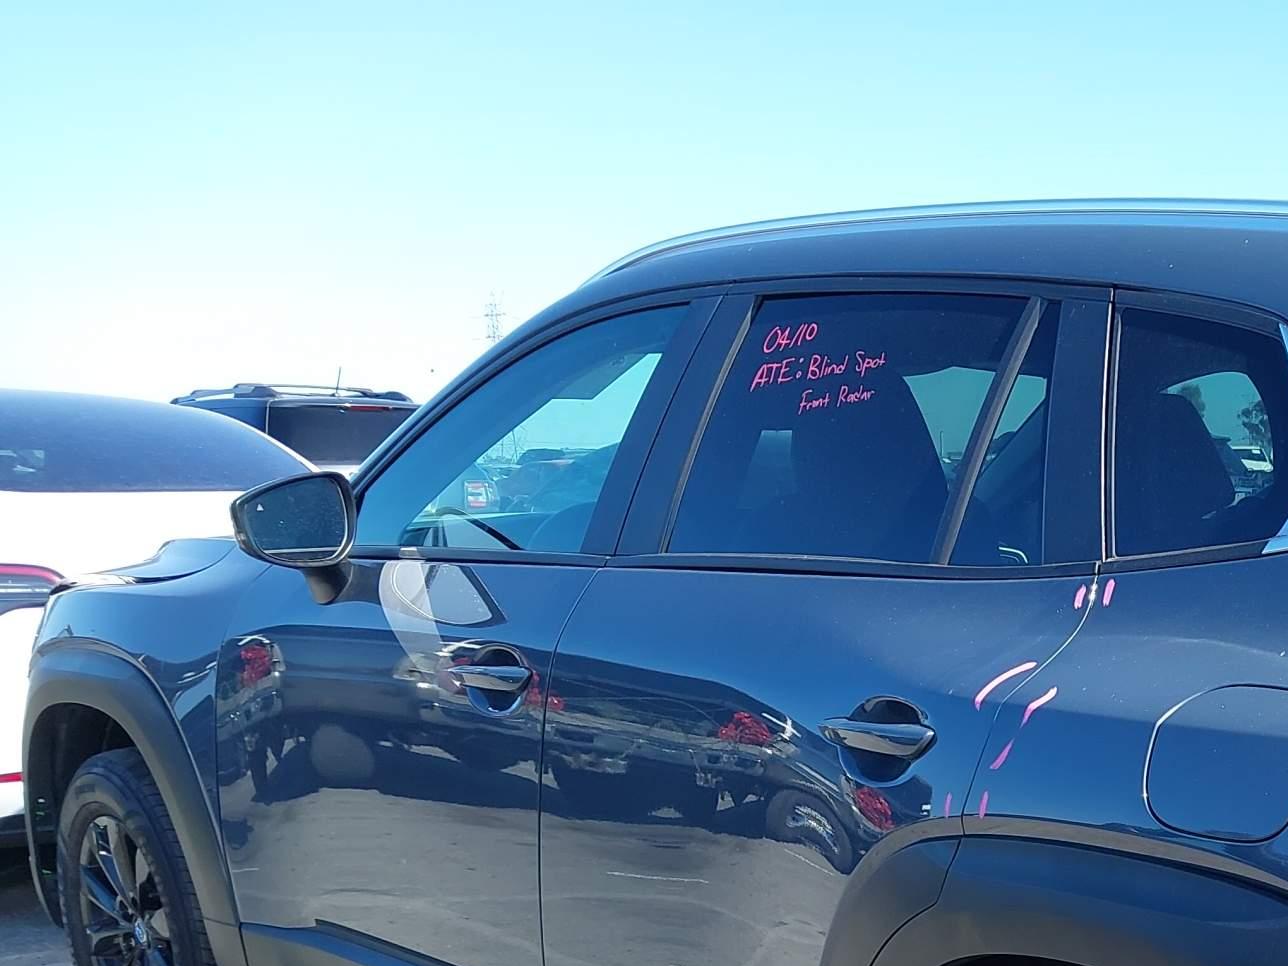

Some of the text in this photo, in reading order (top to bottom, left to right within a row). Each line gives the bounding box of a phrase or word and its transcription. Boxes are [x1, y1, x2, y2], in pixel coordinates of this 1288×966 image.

[763, 322, 818, 354] 04/10
[806, 354, 849, 380] Blind
[855, 350, 886, 377] Spot
[797, 388, 830, 415] Front
